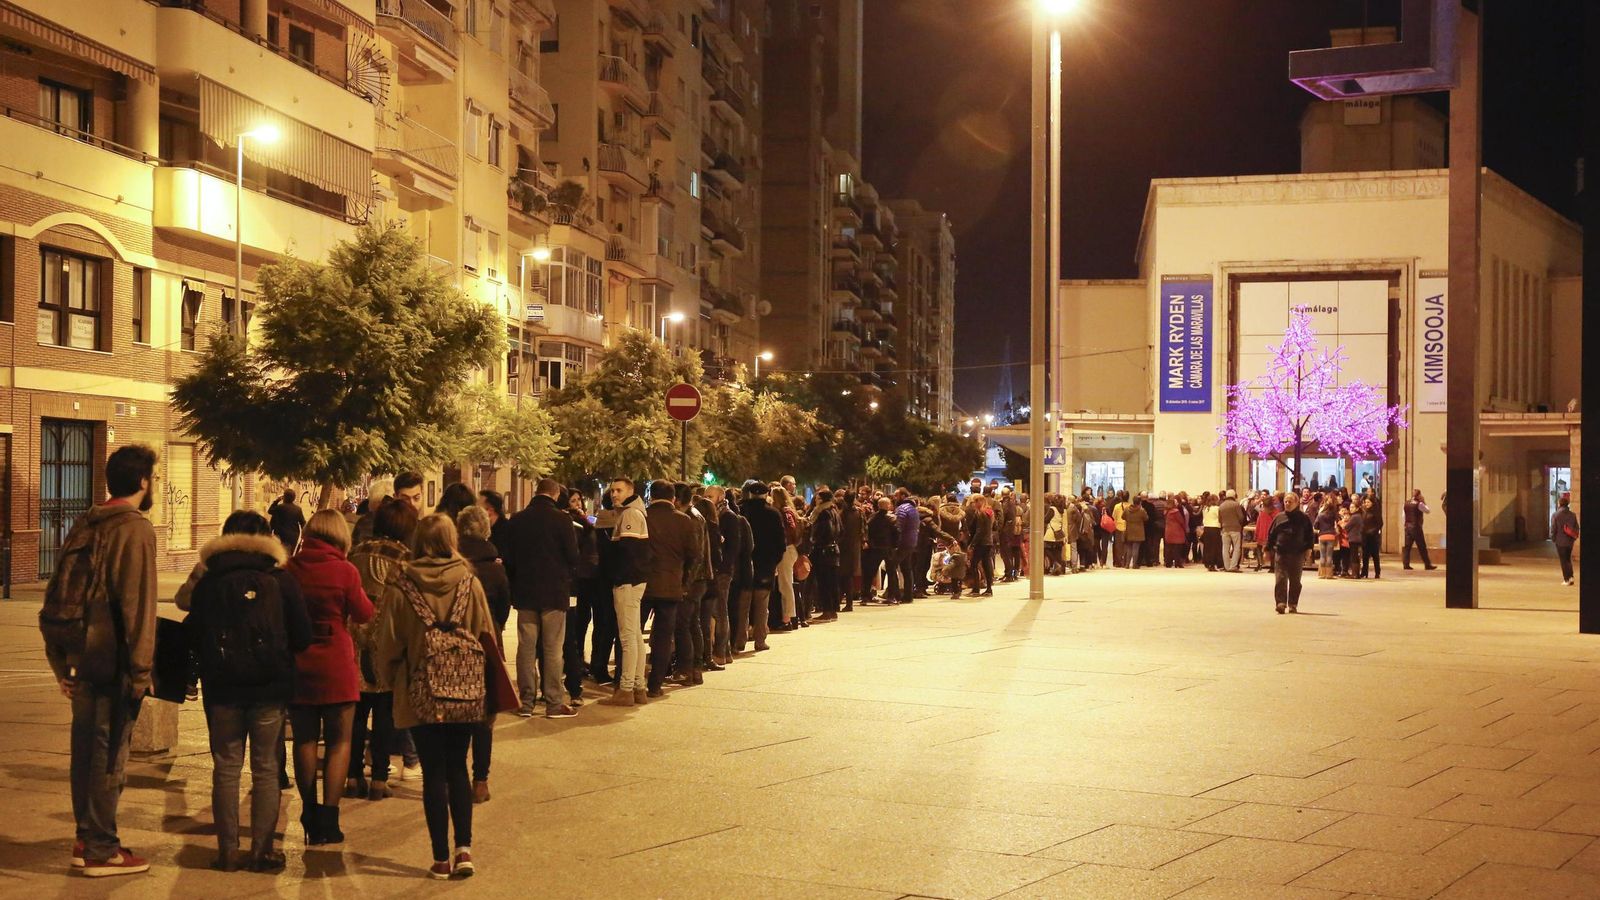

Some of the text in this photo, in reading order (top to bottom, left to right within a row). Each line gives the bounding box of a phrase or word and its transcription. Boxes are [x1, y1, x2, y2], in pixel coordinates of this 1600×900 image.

[1168, 295, 1185, 389] MARK RYDEN
[1187, 294, 1204, 389] CÁMARA DE LAS MARAVILLAS
[1424, 293, 1444, 384] KIMSOOJA
